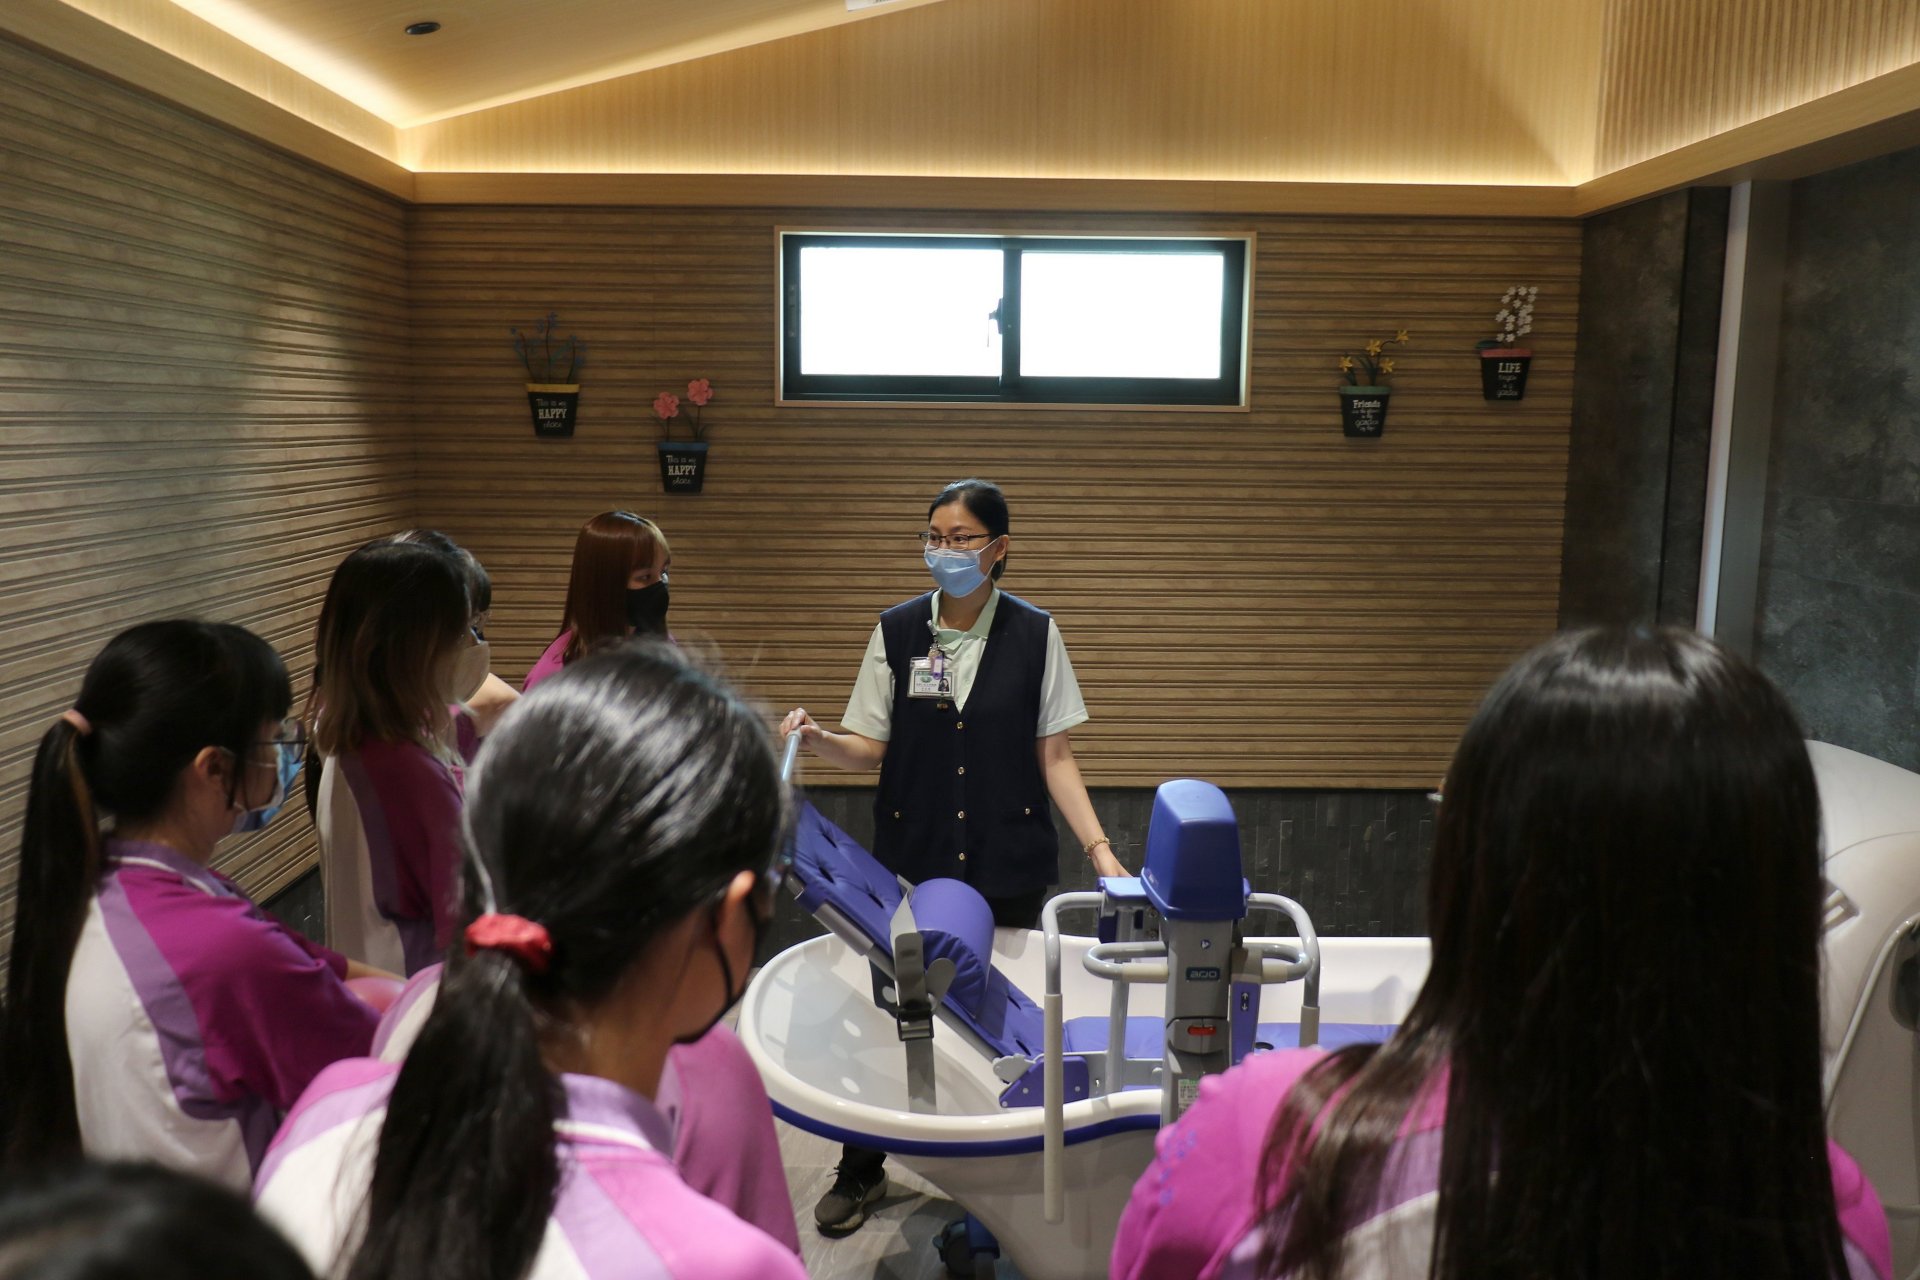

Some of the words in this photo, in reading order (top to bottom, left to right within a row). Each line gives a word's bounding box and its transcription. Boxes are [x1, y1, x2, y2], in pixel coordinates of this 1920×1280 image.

[1498, 362, 1521, 373] LIFE
[538, 408, 567, 419] HAPPY
[668, 464, 697, 476] HAPPY
